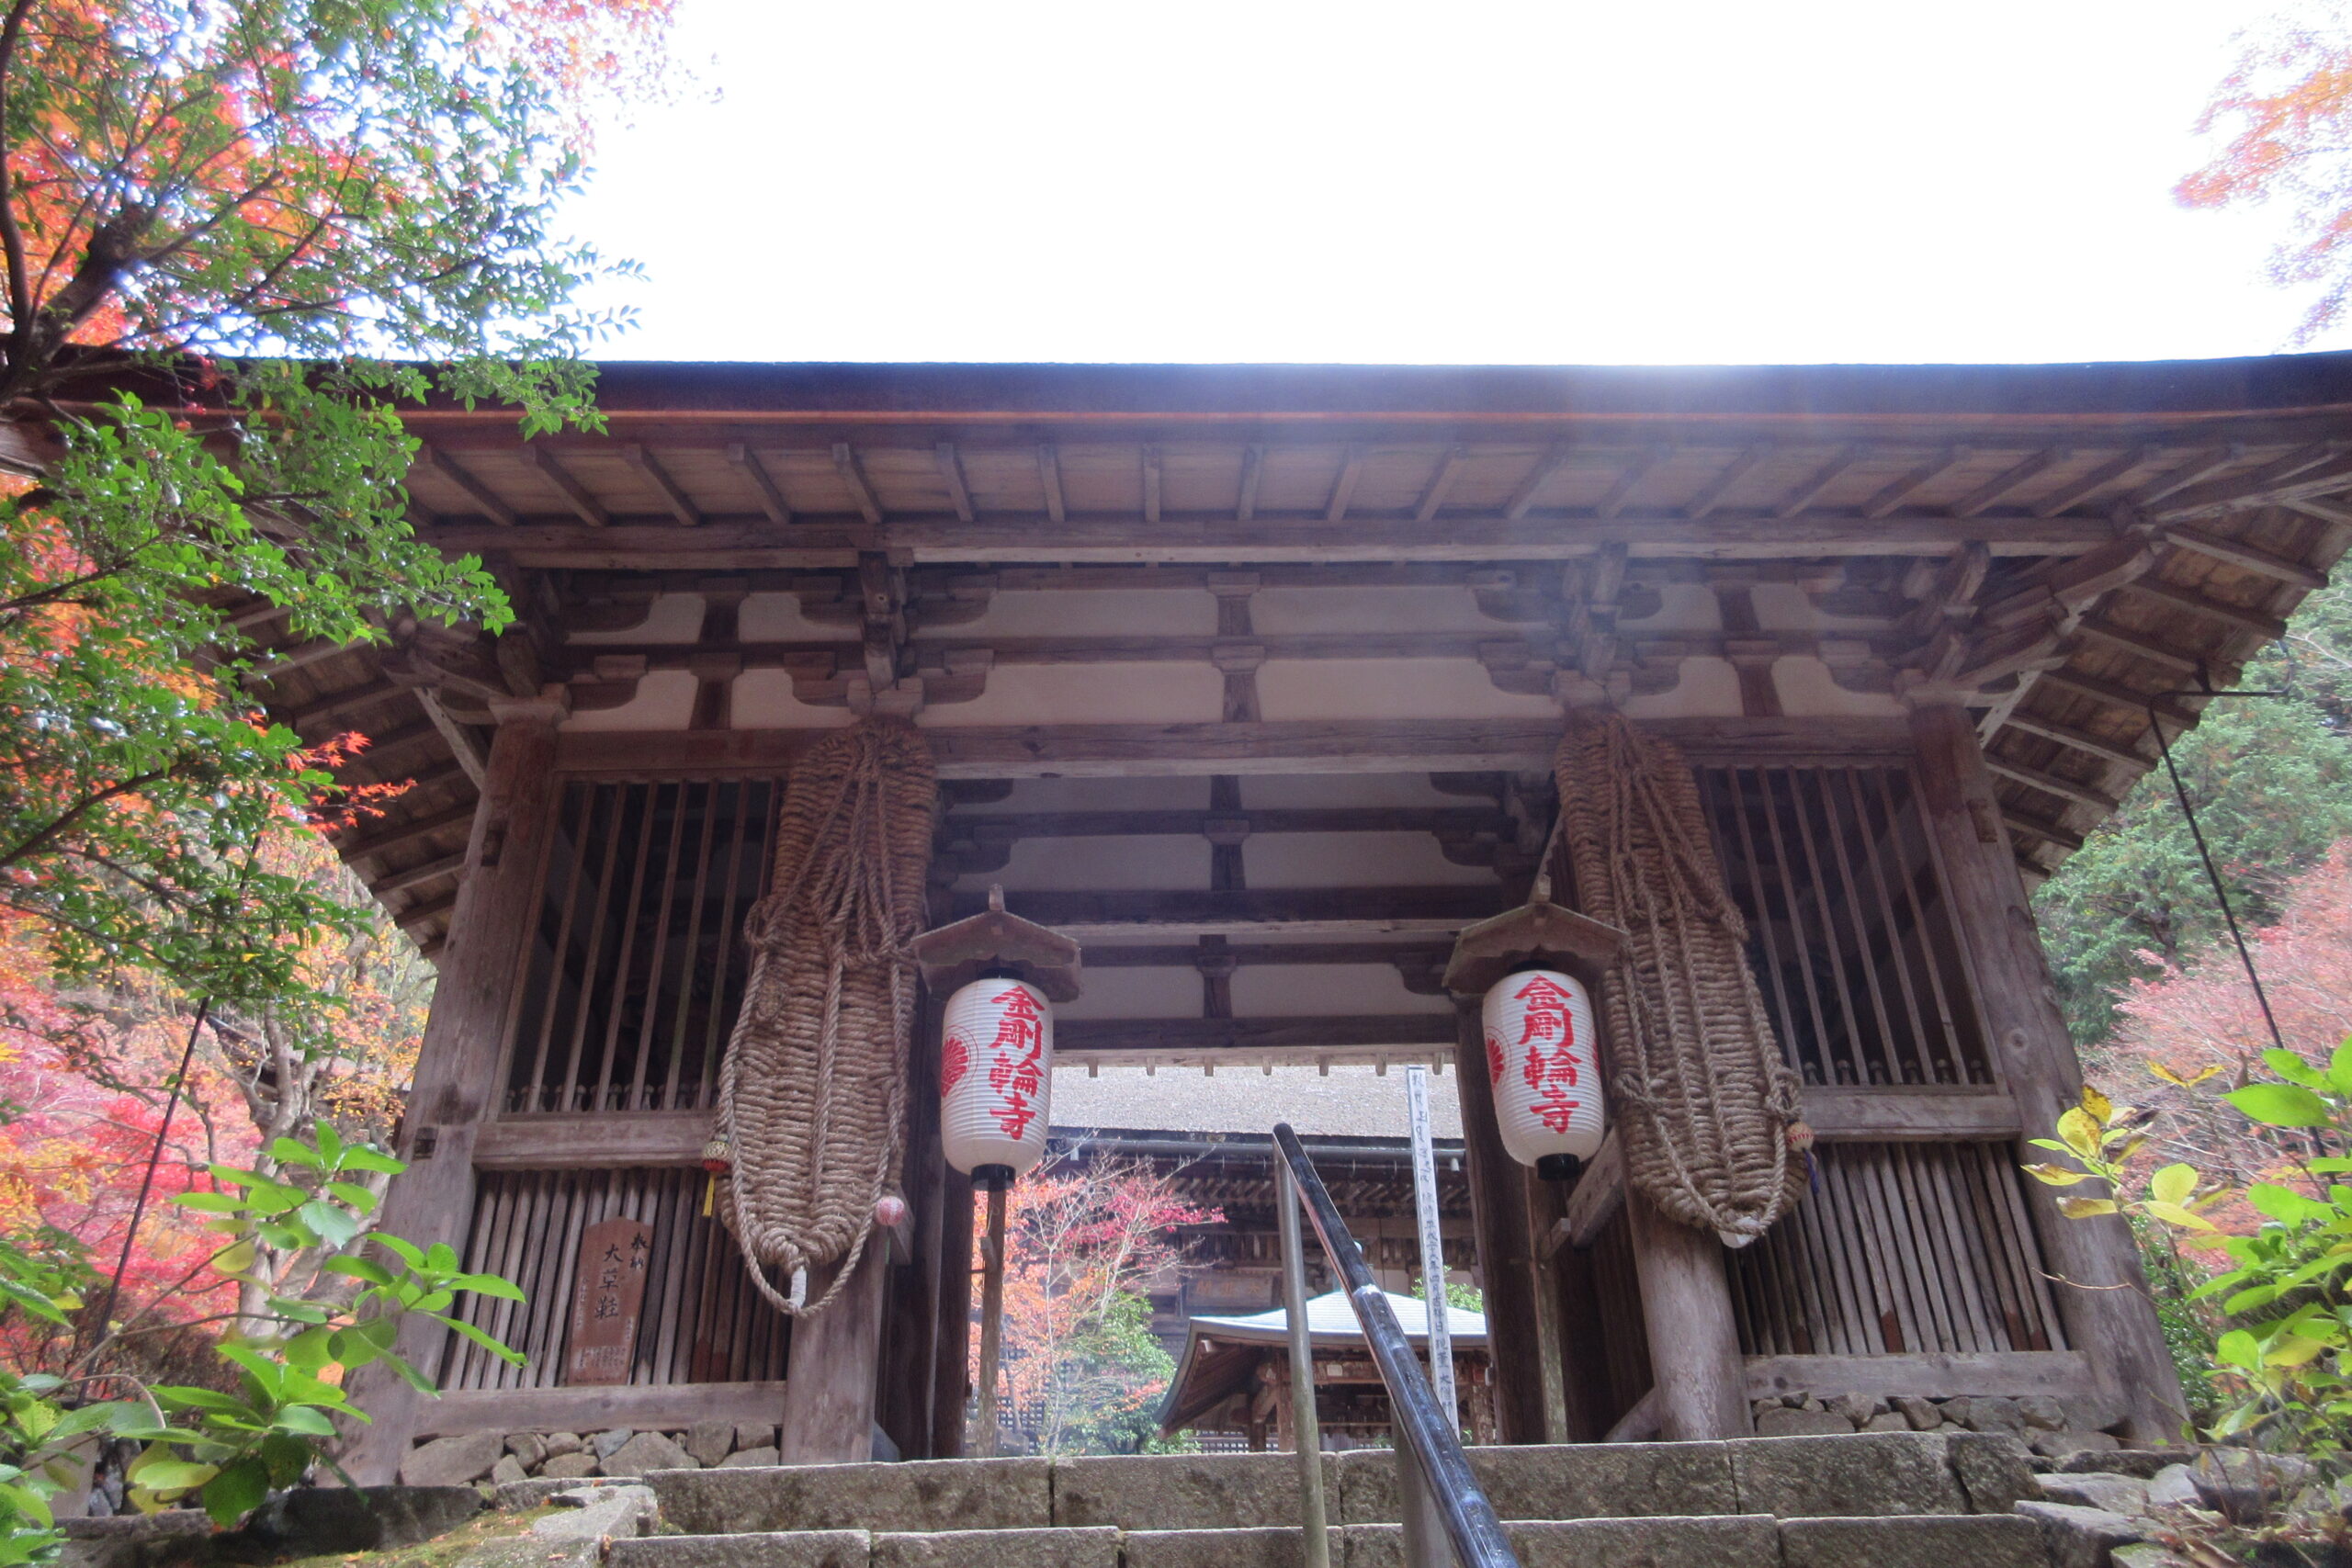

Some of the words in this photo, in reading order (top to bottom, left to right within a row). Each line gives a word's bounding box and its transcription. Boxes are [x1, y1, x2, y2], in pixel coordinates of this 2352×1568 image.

[988, 985, 1046, 1141] 金剛輪寺
[1513, 974, 1582, 1134] 金剛輪寺
[594, 1243, 624, 1320] 大草鞋
[629, 1231, 650, 1270] 奉納
